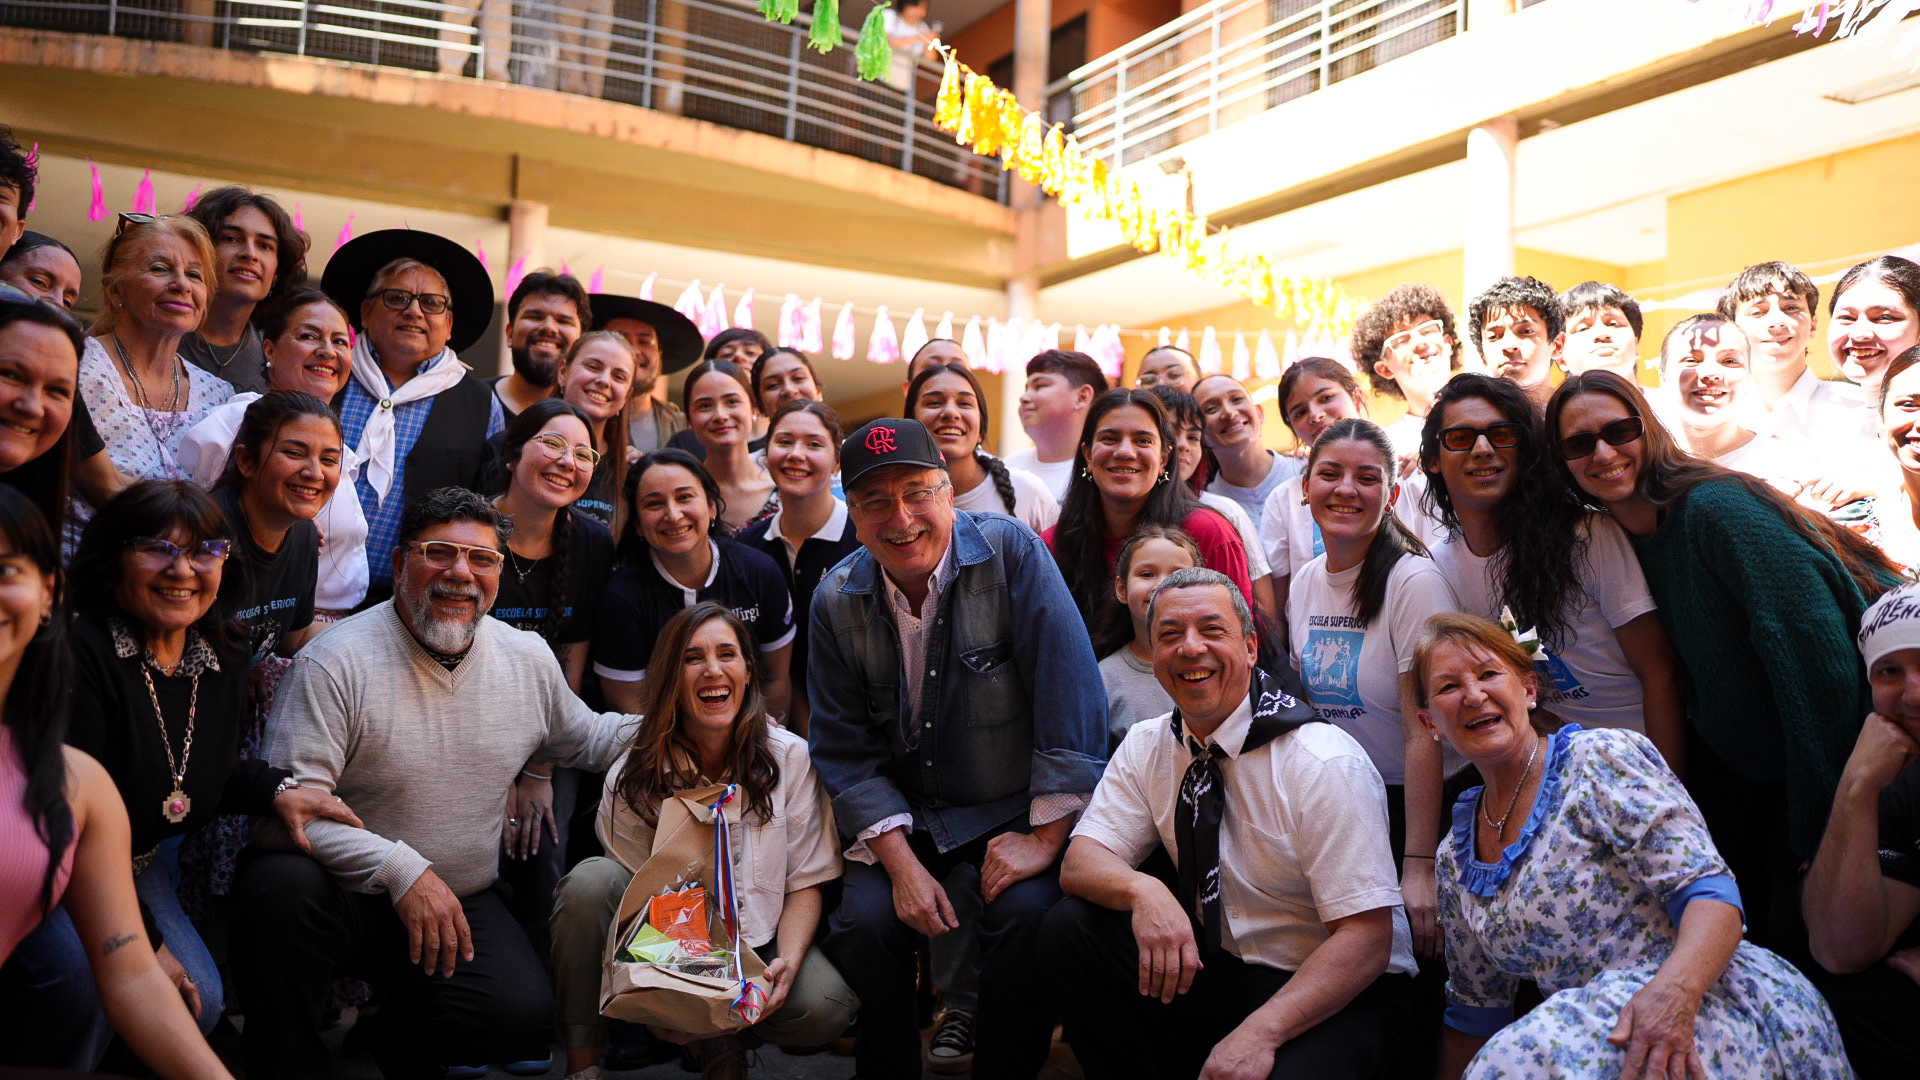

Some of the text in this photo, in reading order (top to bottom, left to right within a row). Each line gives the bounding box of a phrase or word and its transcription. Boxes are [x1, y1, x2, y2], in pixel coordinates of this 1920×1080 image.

[576, 499, 615, 511] SUPERIO
[263, 597, 297, 615] SERIOR
[495, 607, 533, 618] ESCUELA
